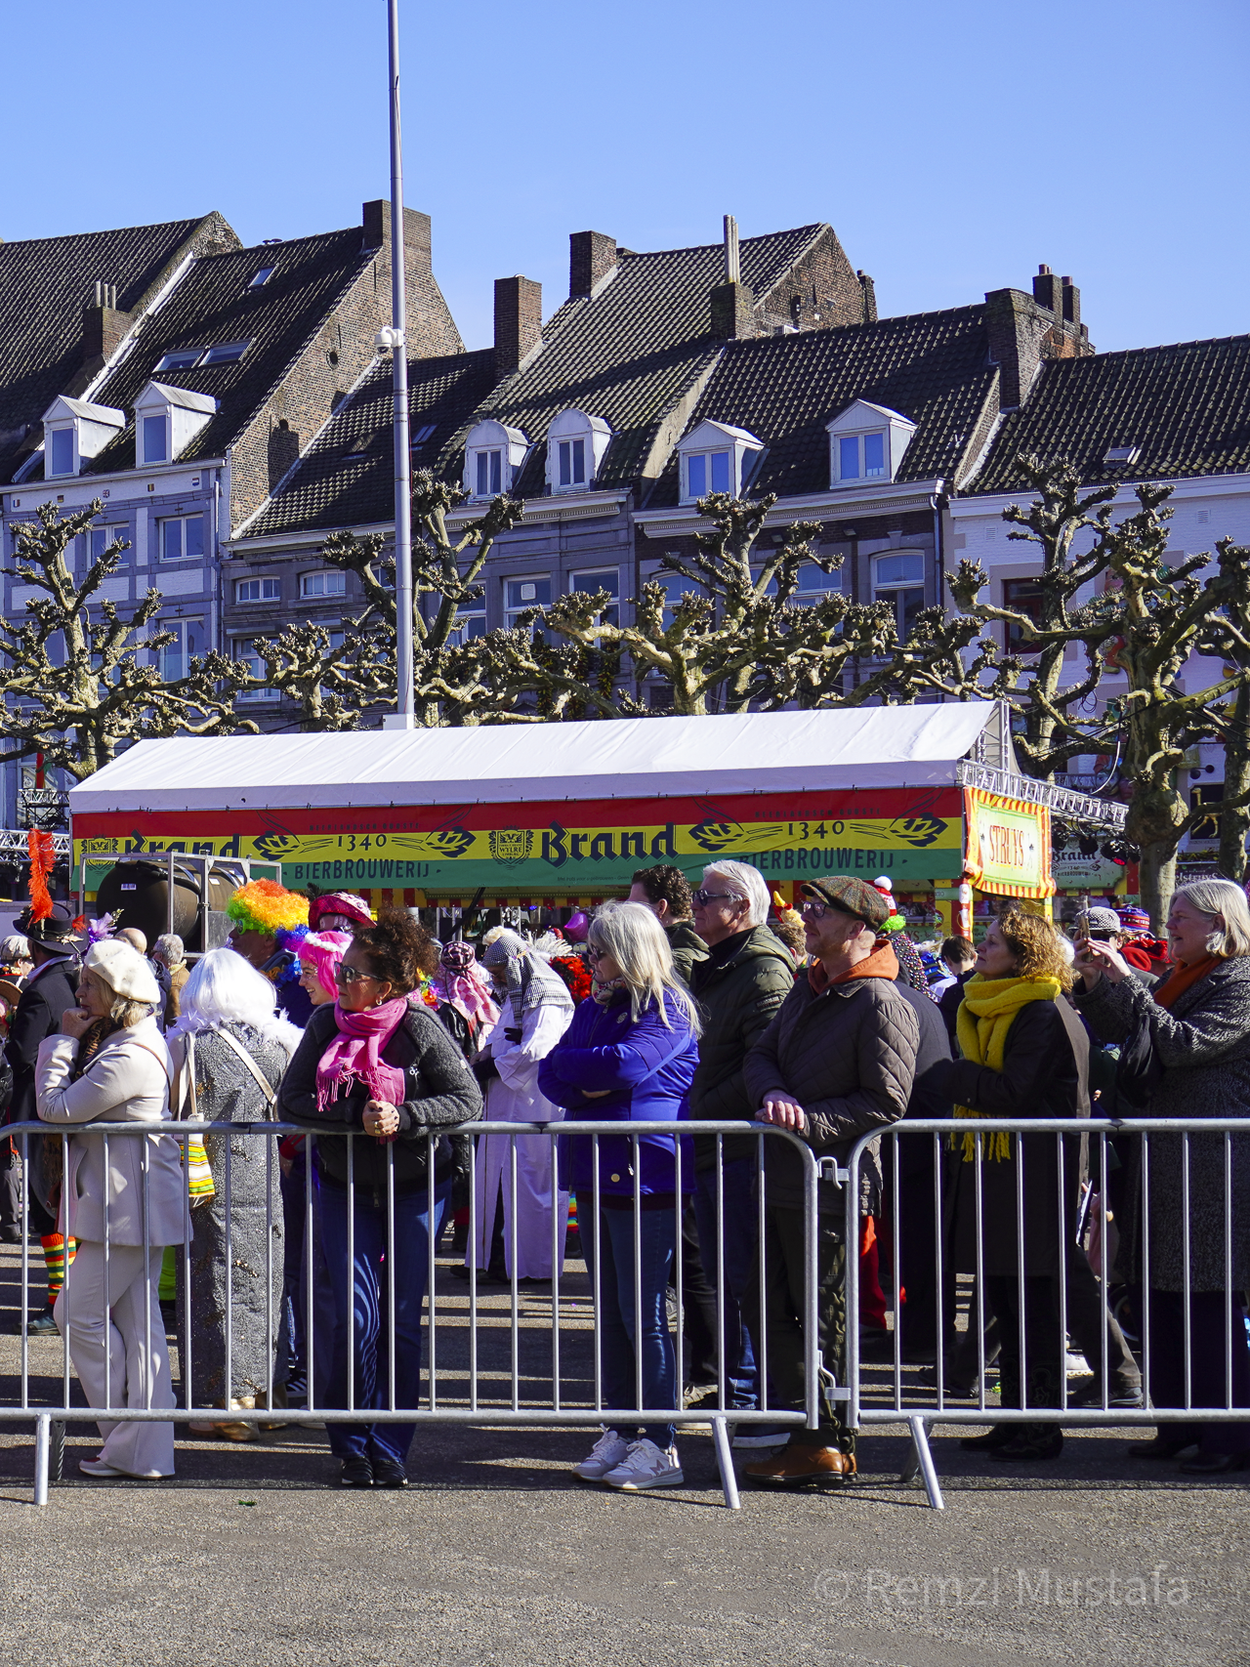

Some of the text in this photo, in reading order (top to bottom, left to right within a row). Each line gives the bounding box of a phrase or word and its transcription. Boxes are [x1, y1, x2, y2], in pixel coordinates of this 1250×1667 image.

[788, 820, 845, 840] 1340
[337, 834, 388, 852] 1340
[540, 820, 679, 868] Brand
[989, 824, 1025, 868] STRUYS
[294, 858, 430, 880] BIERBROUWERIJ
